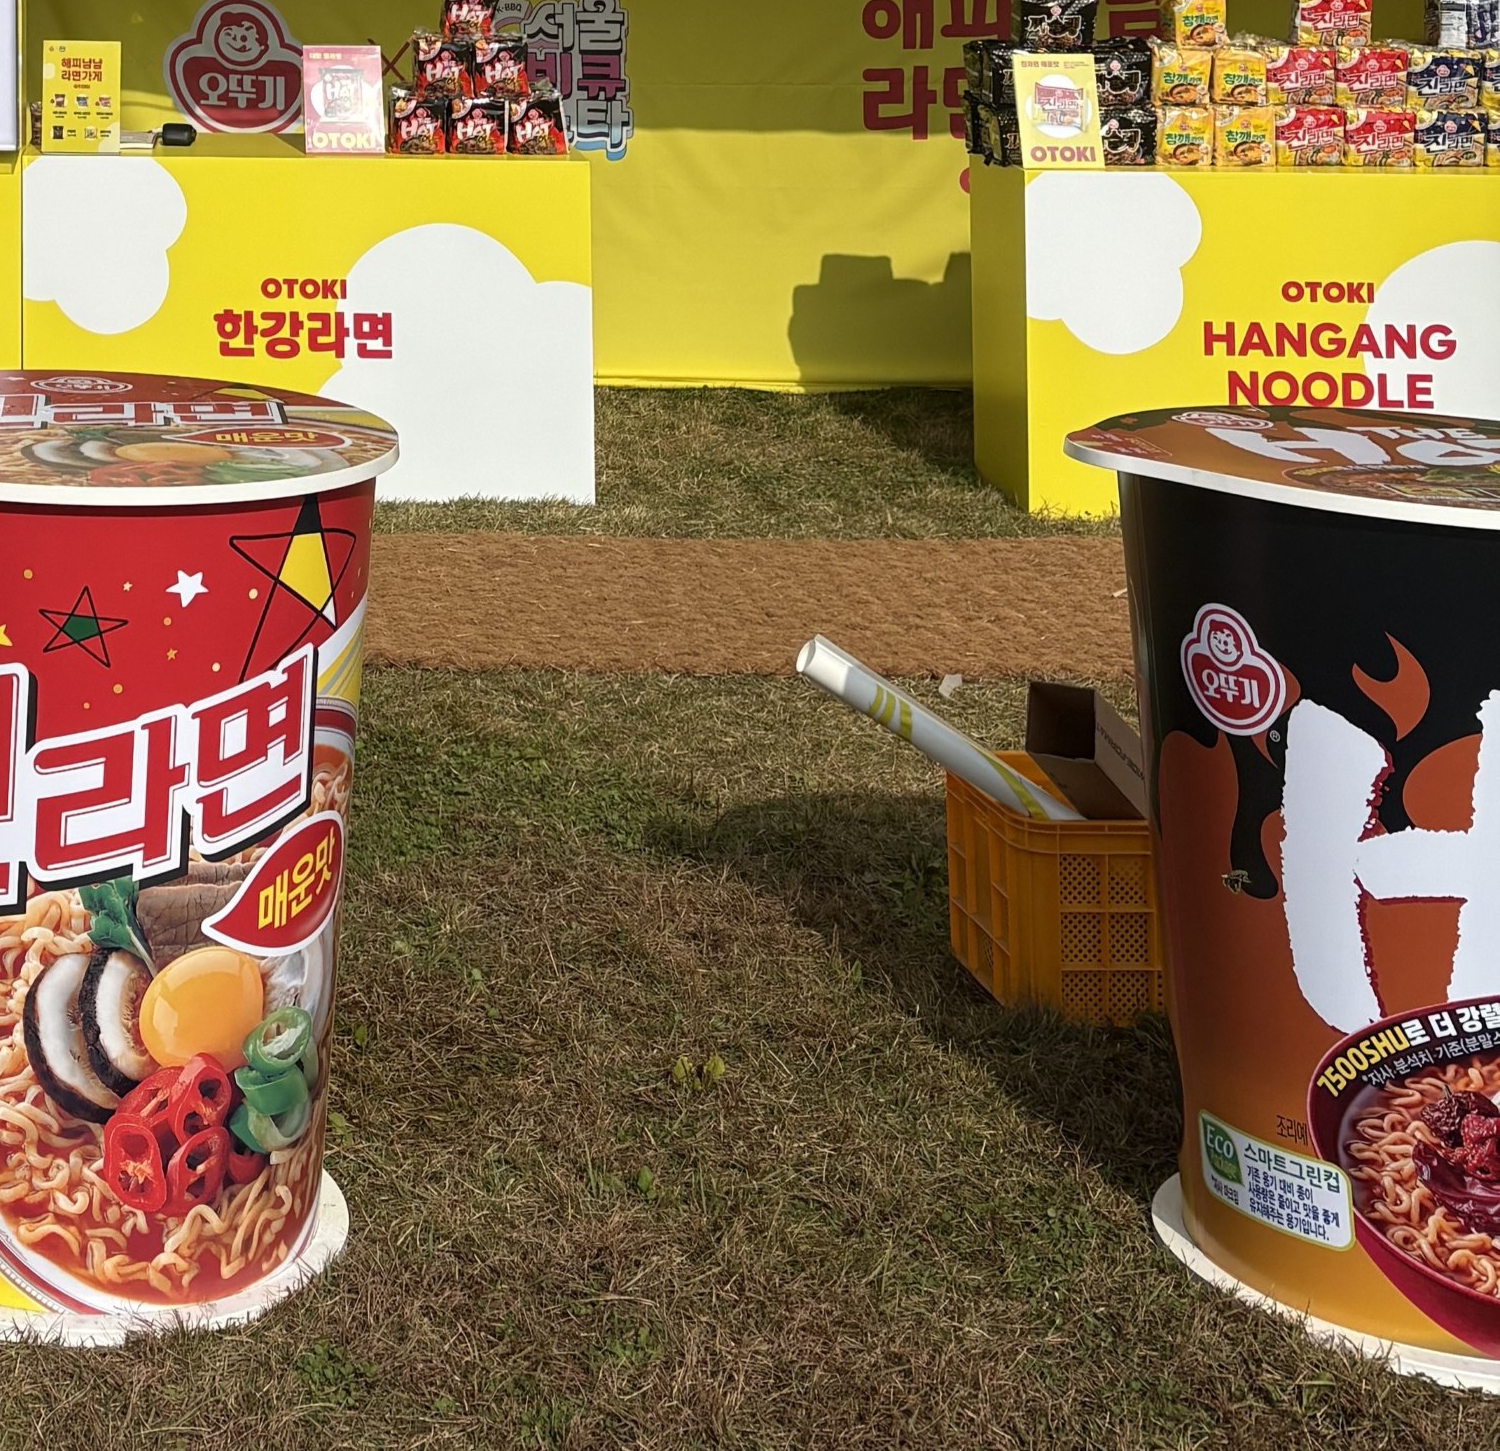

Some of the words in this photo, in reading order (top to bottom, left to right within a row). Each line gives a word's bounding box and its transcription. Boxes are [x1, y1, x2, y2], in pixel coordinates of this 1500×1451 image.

[450, 2, 489, 25] HOT
[1312, 11, 1361, 33] 진라면
[61, 70, 103, 82] 라면가게
[426, 60, 464, 83] HOT
[485, 62, 523, 84] HOT
[1277, 72, 1327, 93] 진라면
[1348, 72, 1398, 93] 진라면
[199, 72, 285, 111] 오뚜기
[1416, 76, 1468, 98] 진라면
[401, 118, 438, 140] HOT
[456, 121, 494, 141] HOT
[516, 121, 552, 141] HOT
[1285, 129, 1334, 151] 진라면
[1030, 146, 1097, 163] OTOKI
[1355, 132, 1405, 155] 진라면
[1423, 133, 1474, 154] 진라면
[260, 278, 347, 300] OTOKI
[1281, 281, 1375, 304] OTOKI
[214, 309, 393, 359] 한강라면
[1203, 321, 1457, 361] HANGANG
[1228, 370, 1434, 410] NOODLE
[215, 430, 318, 445] 매운맛
[1346, 426, 1488, 441] THE
[1201, 667, 1261, 710] 오뚜기
[257, 829, 337, 930] 매운맛
[1316, 1018, 1431, 1098] 7500SHU로
[1428, 1011, 1458, 1039] 더
[1393, 1048, 1435, 1075] 분석치
[1206, 1124, 1234, 1159] ECO
[1276, 1114, 1309, 1147] 조리예
[1244, 1142, 1341, 1194] 스마트그린컵
[1262, 1171, 1277, 1191] 용기
[1279, 1178, 1295, 1197] 대비
[1296, 1185, 1314, 1204] 종이
[1248, 1200, 1285, 1226] 유지해주는
[1286, 1214, 1330, 1241] 용기입니다.
[1303, 1202, 1320, 1221] 맛을
[1322, 1209, 1340, 1228] 좋게
